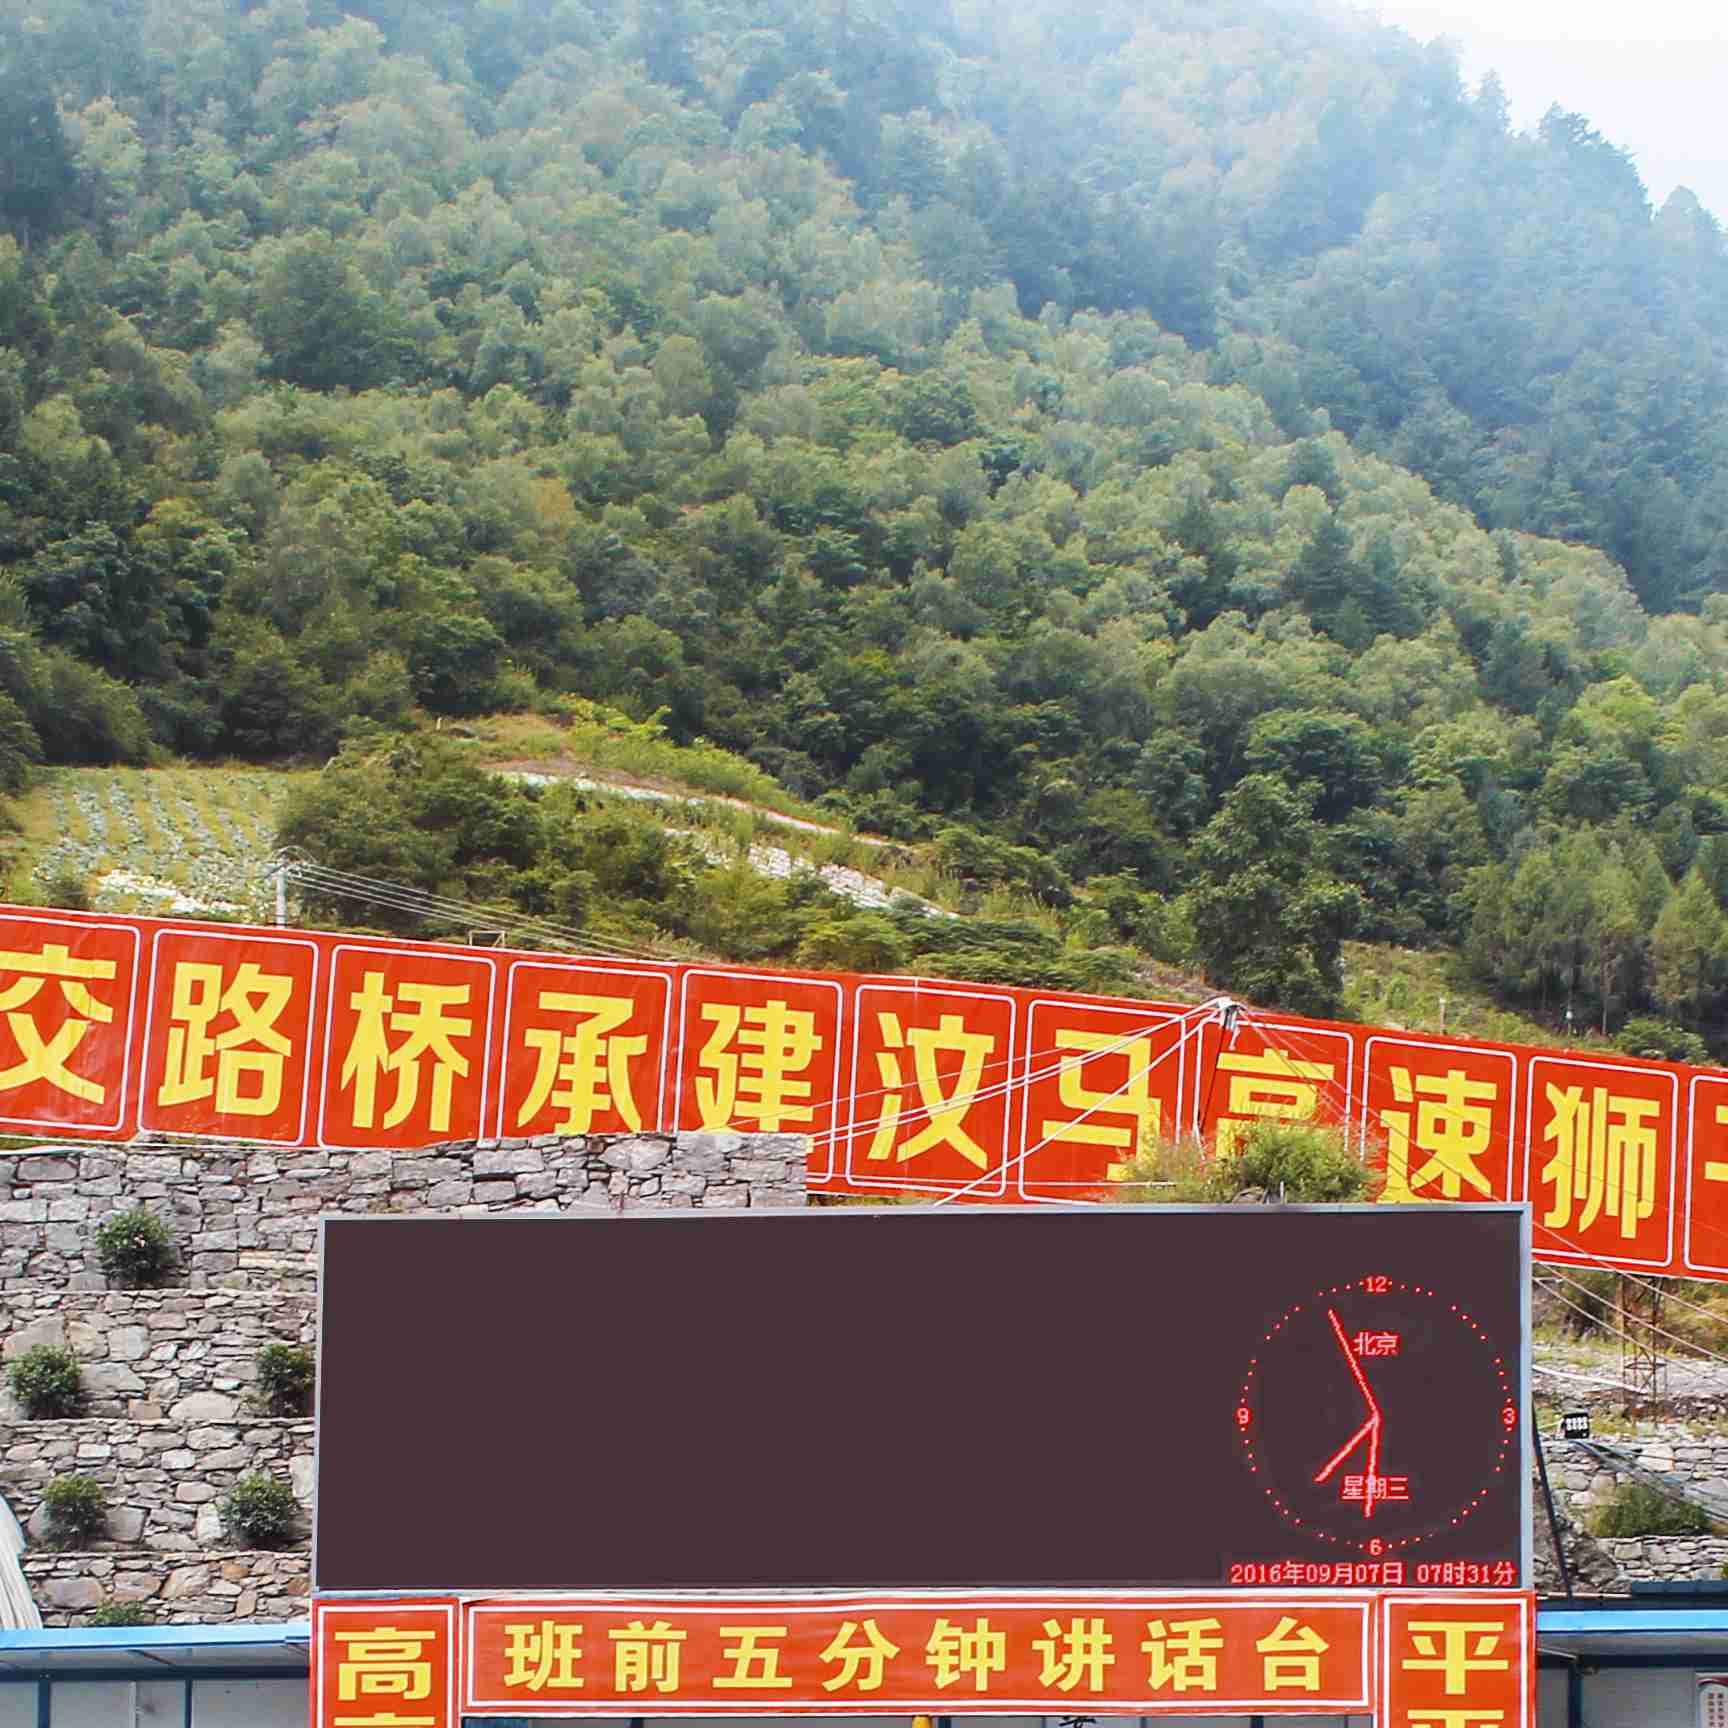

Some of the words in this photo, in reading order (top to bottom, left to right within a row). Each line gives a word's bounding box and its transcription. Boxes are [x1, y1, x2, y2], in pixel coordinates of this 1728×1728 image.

[1364, 1276, 1389, 1293] 12
[1353, 1332, 1400, 1356] 北京
[1236, 1409, 1250, 1425] 9
[1502, 1409, 1516, 1425] 3
[1341, 1475, 1410, 1501] 星期三
[1369, 1539, 1383, 1556] 6
[1230, 1560, 1404, 1586] 2016年09月07日
[1416, 1560, 1517, 1586] 07时31分
[503, 1616, 1330, 1693] 班前五分钟讲话台
